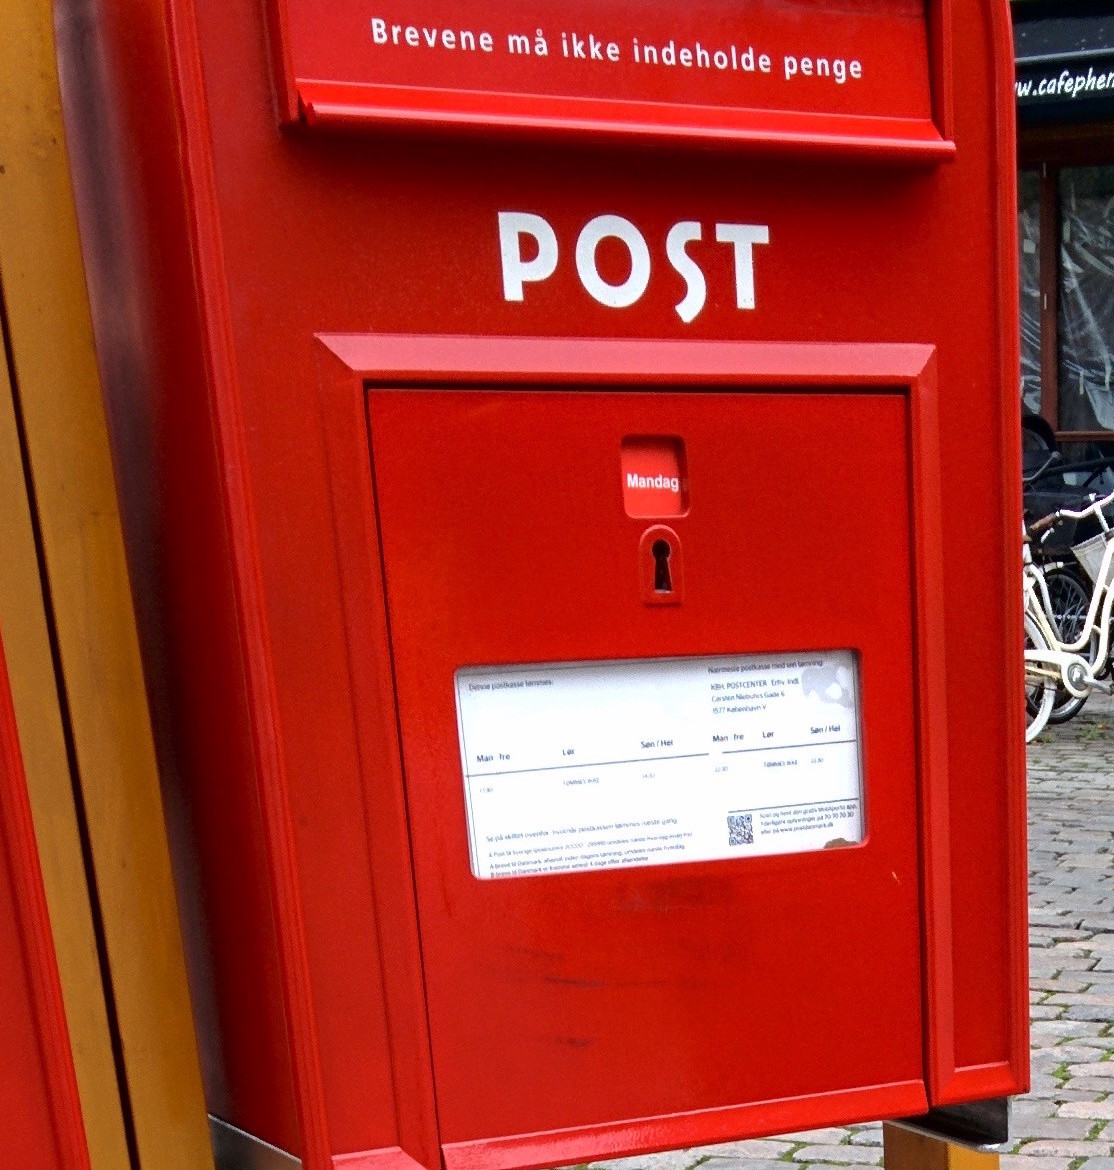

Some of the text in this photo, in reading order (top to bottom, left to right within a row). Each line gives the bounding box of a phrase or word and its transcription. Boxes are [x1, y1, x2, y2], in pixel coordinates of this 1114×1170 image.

[370, 17, 863, 84] Brevene må ikke indeholde penge
[497, 211, 770, 323] POST
[627, 473, 679, 492] Mandag
[713, 734, 729, 742] Man
[762, 731, 774, 739] Lør
[477, 754, 494, 762] Man
